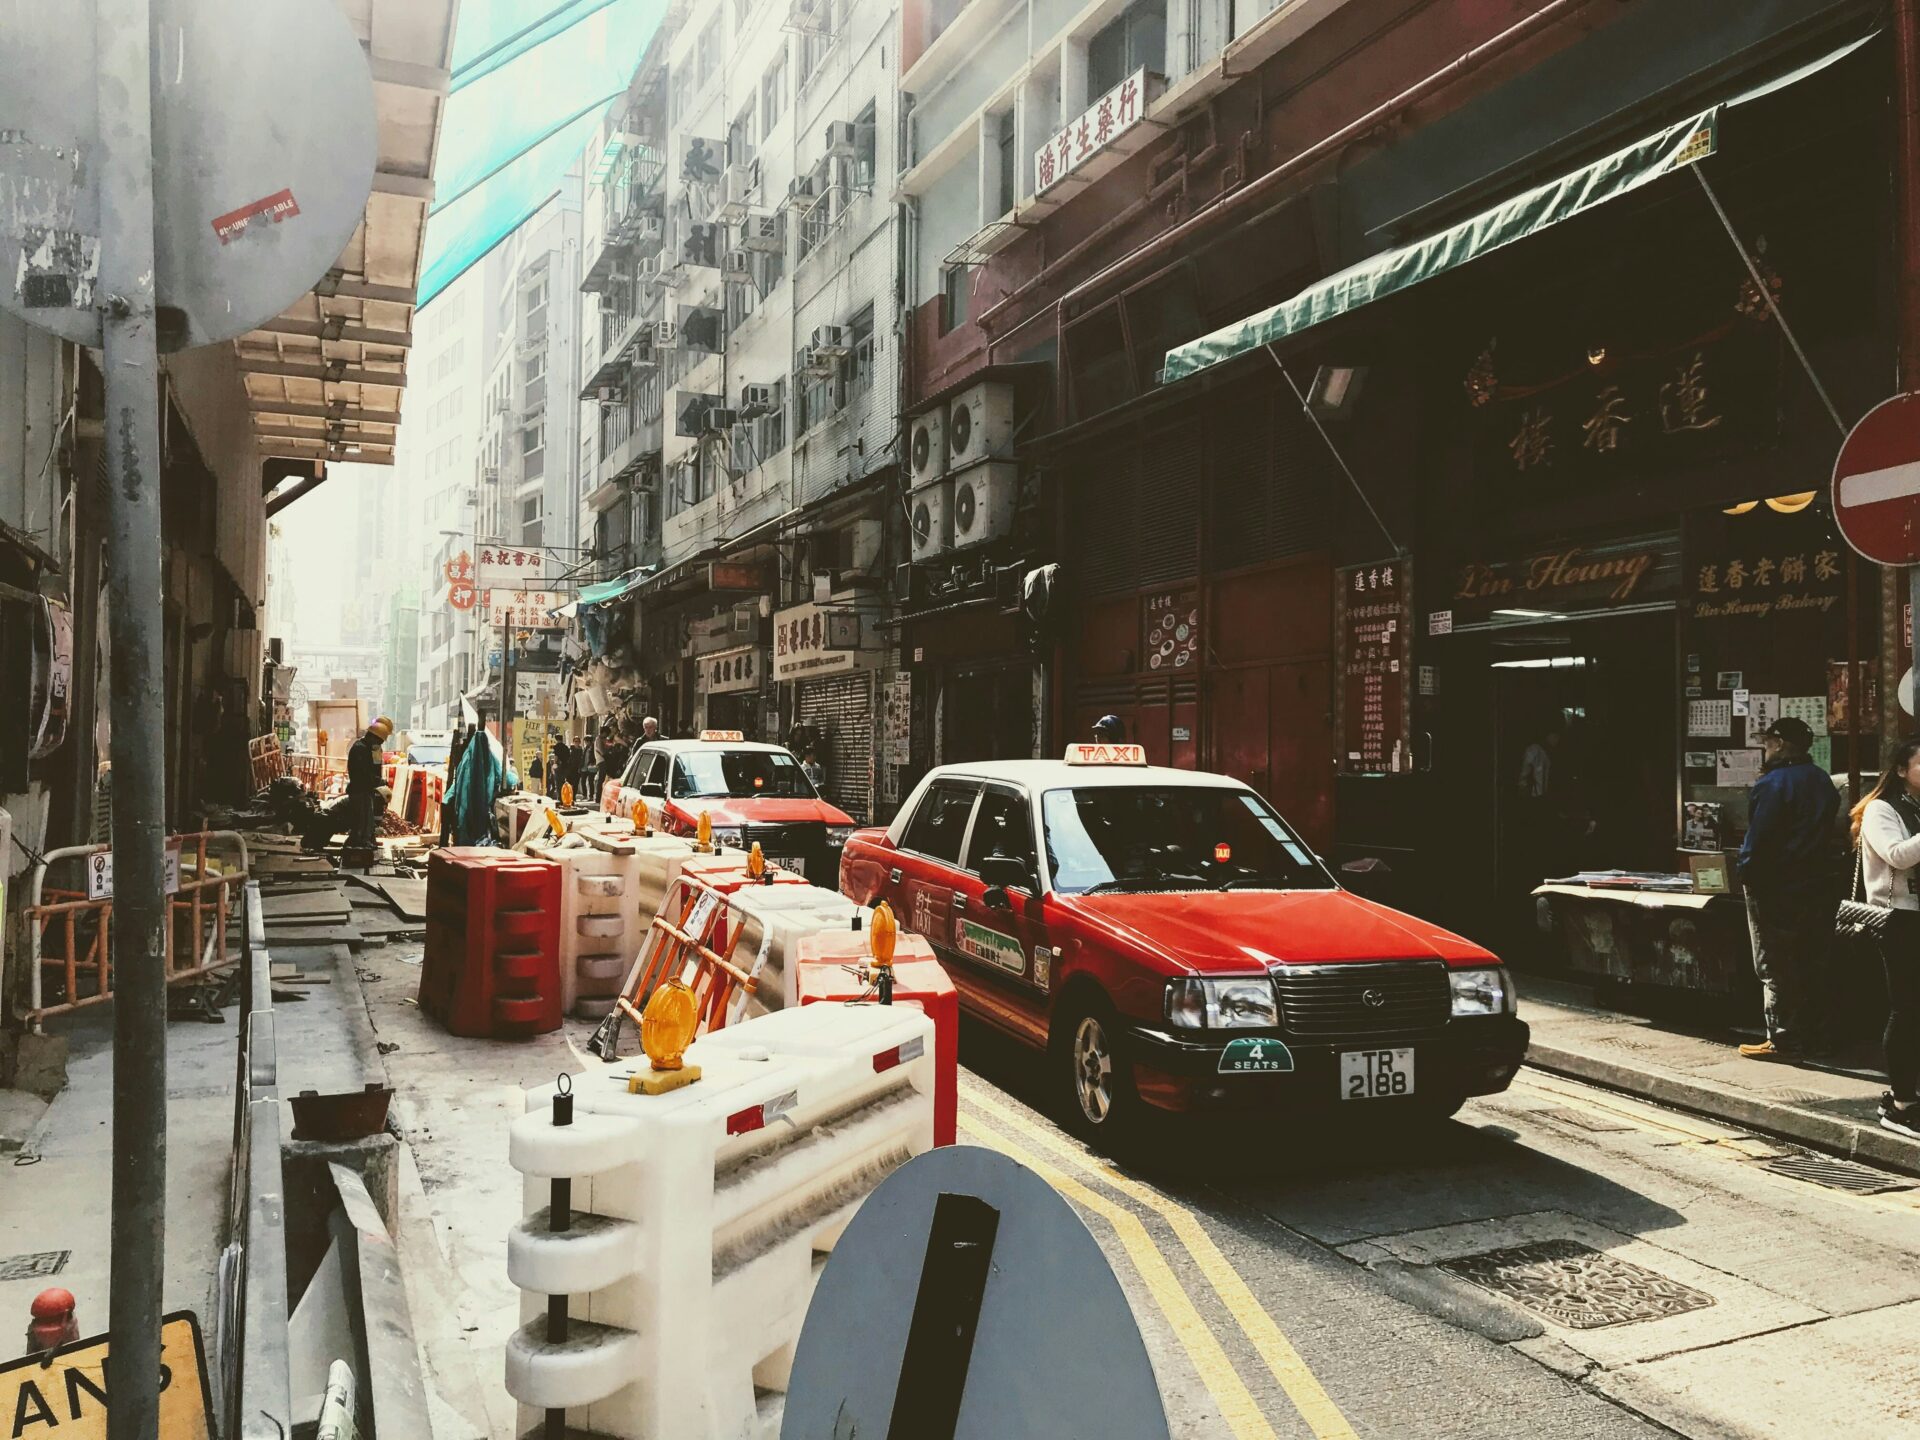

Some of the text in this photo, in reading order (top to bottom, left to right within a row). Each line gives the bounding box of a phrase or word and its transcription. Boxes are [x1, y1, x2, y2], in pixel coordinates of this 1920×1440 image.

[1355, 566, 1394, 592] 蓮香樓
[1453, 547, 1649, 600] Lin Heung
[1697, 549, 1840, 593] 蓮香老餅家
[706, 731, 741, 740] TAXI
[1078, 746, 1139, 761] TAXI
[915, 888, 932, 914] 的士
[915, 910, 931, 935] TAXI
[1249, 1044, 1264, 1060] 4
[1361, 1050, 1393, 1074] TR
[1234, 1061, 1279, 1070] SEATS
[1348, 1071, 1406, 1098] 2188
